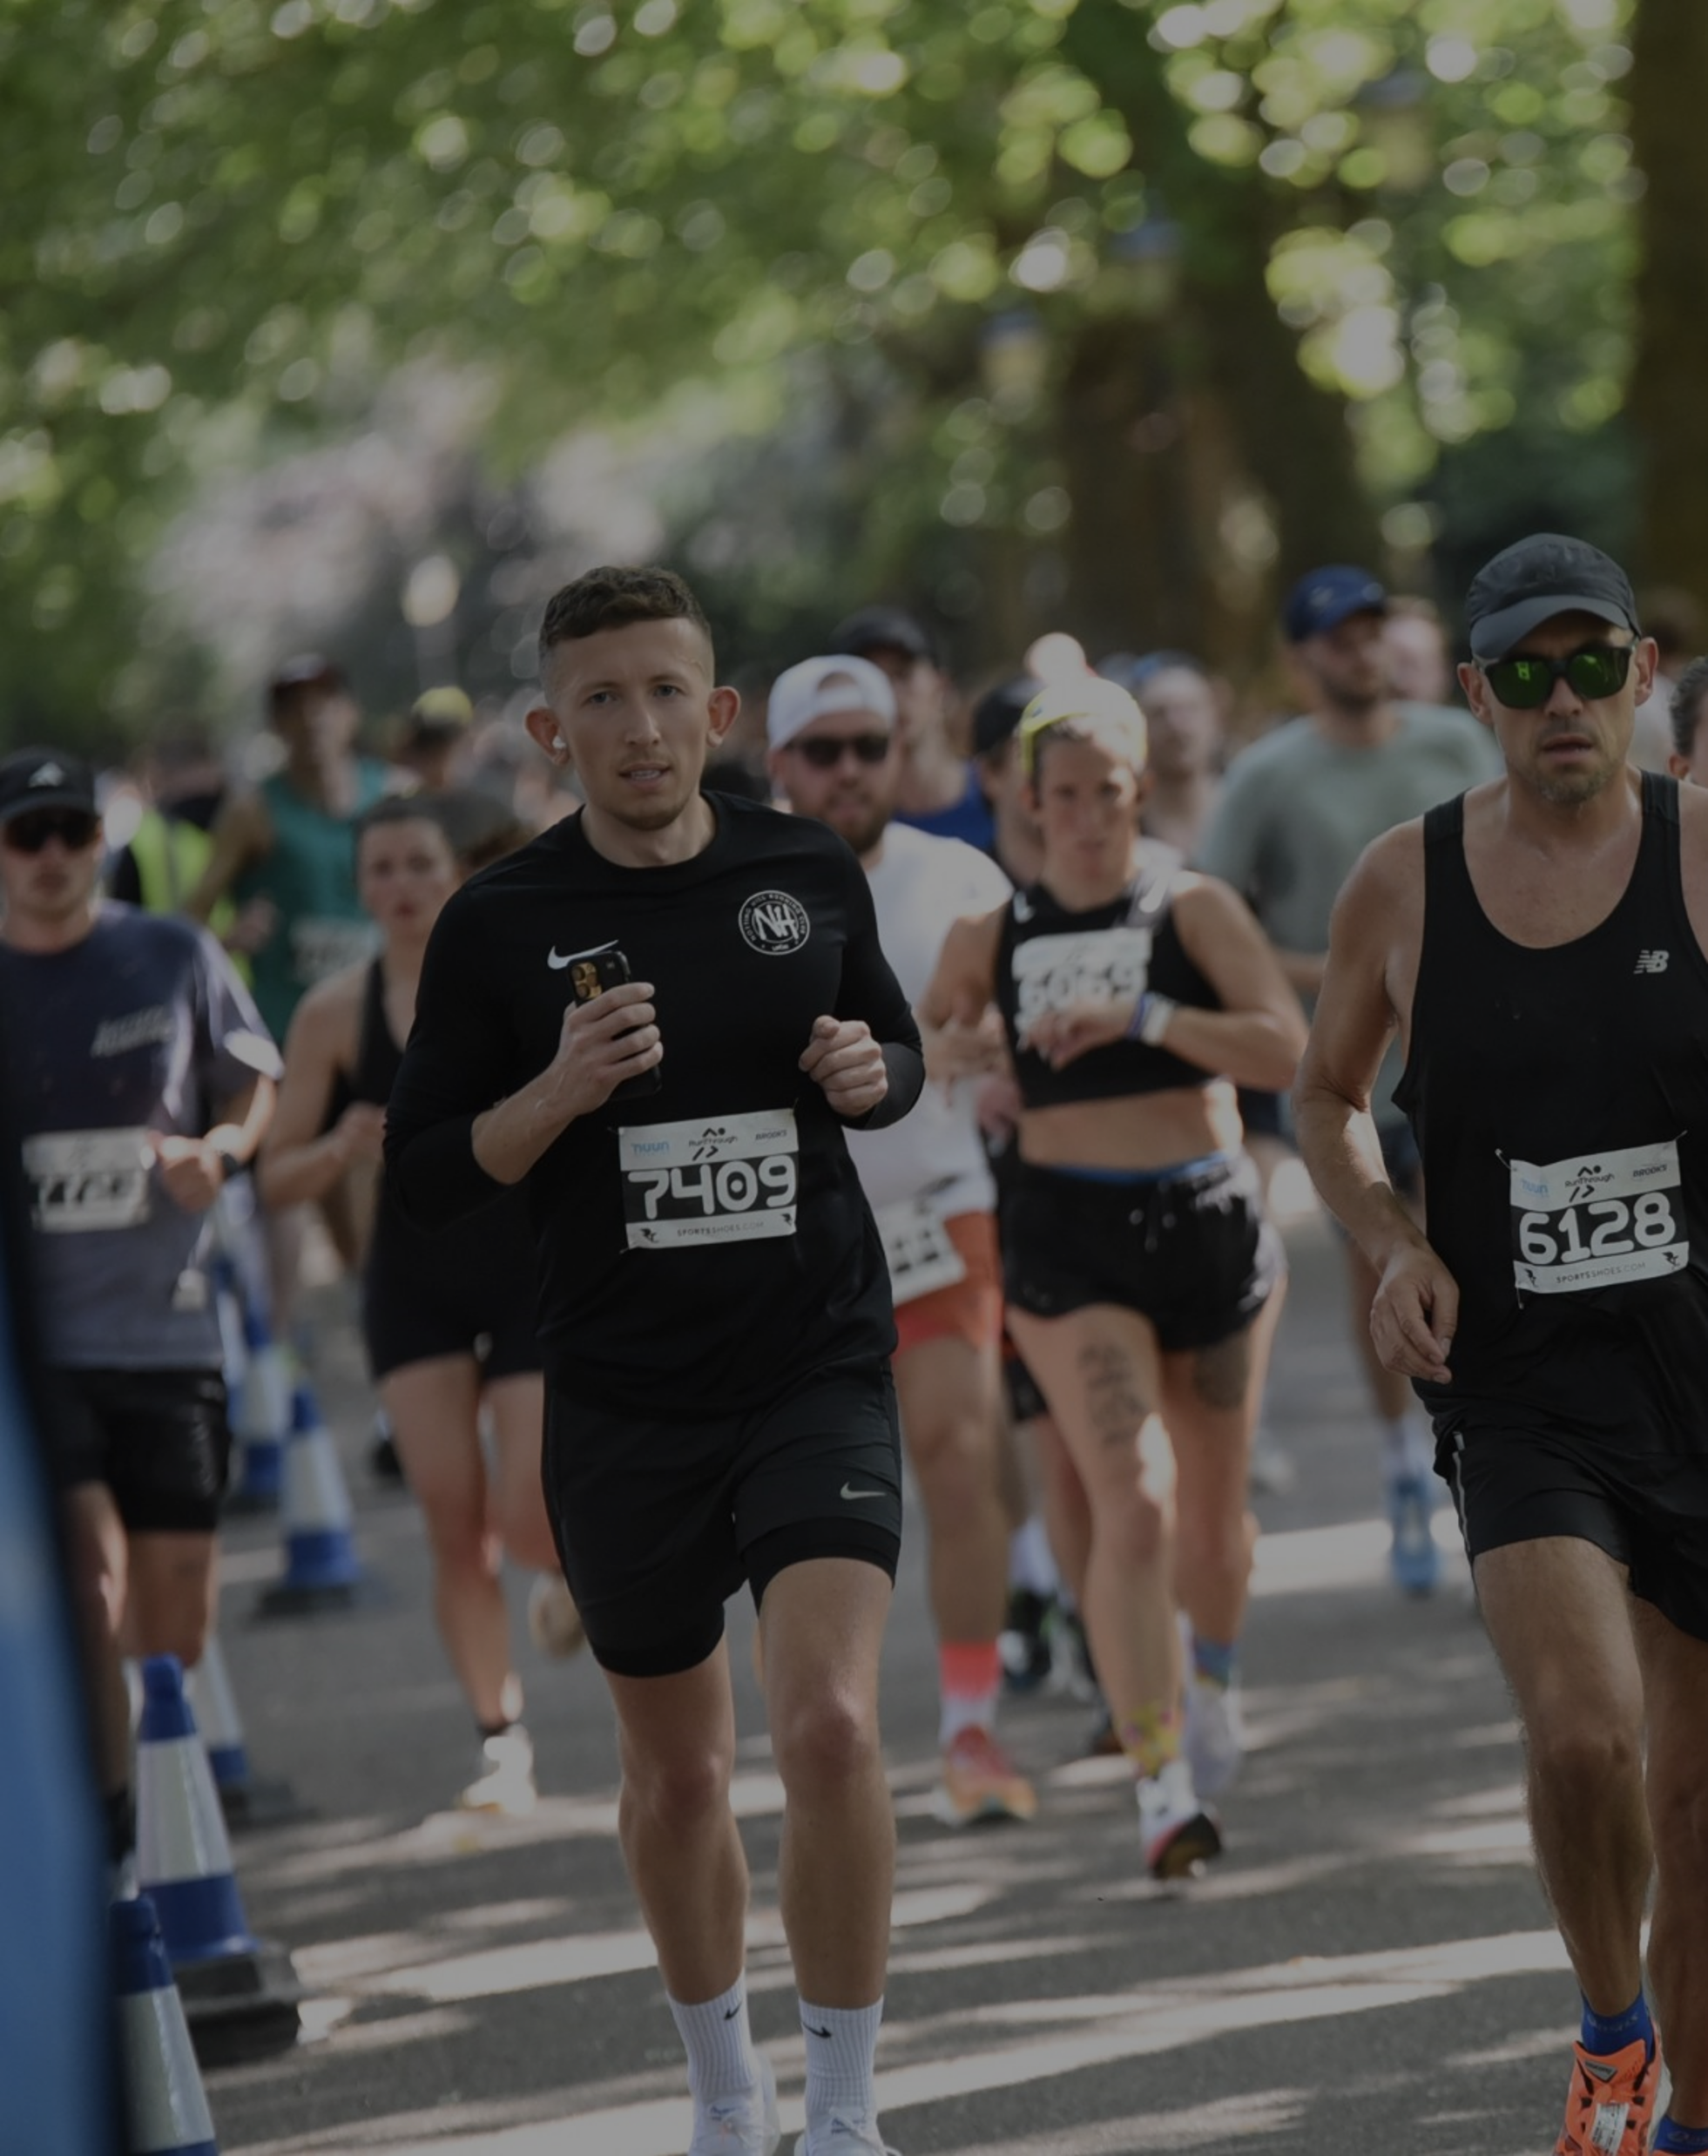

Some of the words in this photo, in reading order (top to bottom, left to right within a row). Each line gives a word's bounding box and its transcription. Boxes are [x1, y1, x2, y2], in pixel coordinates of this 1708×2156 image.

[754, 1129, 787, 1141] BROOKS
[1632, 1164, 1668, 1178] BROOKS
[627, 1154, 797, 1220] 7409
[1564, 1173, 1616, 1188] RunThrough
[677, 1221, 765, 1237] SPORTSSHOES.COM
[1519, 1191, 1677, 1265] 6128
[1556, 1262, 1646, 1284] SPORTSSHOES.COM
